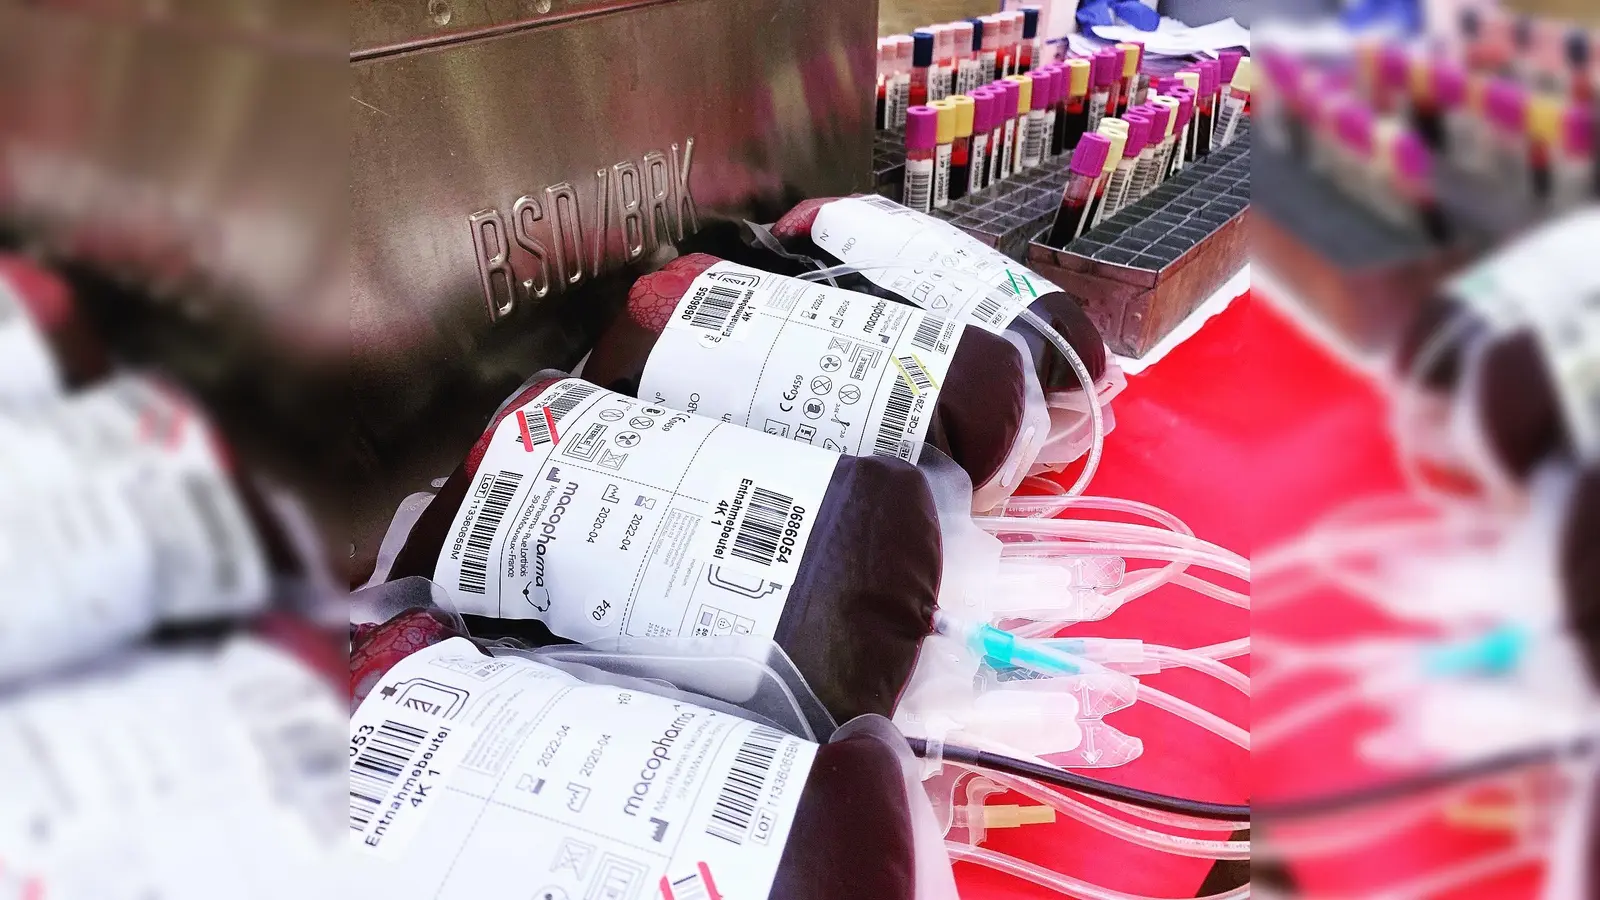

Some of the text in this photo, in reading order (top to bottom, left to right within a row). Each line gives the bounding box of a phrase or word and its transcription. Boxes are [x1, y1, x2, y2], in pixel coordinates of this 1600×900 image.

[469, 137, 699, 323] BSD/BRK
[682, 287, 709, 320] 0686055
[722, 289, 755, 337] Entnahmebeutel
[742, 311, 754, 322] 4K
[900, 442, 911, 459] REF
[907, 414, 920, 434] FQE
[450, 477, 492, 560] LOT 11336065BM
[586, 506, 610, 544] 2020-04
[713, 478, 753, 560] Entnahmebeutel
[714, 500, 729, 516] 4K
[535, 481, 579, 587] macopharma
[619, 514, 642, 551] 2022-04
[776, 505, 805, 564] 0686054
[592, 599, 611, 621] 034
[537, 724, 571, 768] 2022-04
[580, 733, 612, 777] 2020-04
[623, 711, 696, 817] macopharma
[365, 726, 451, 847] Entnahmebeutel
[411, 769, 441, 808] 4K 1
[755, 815, 772, 841] LOT
